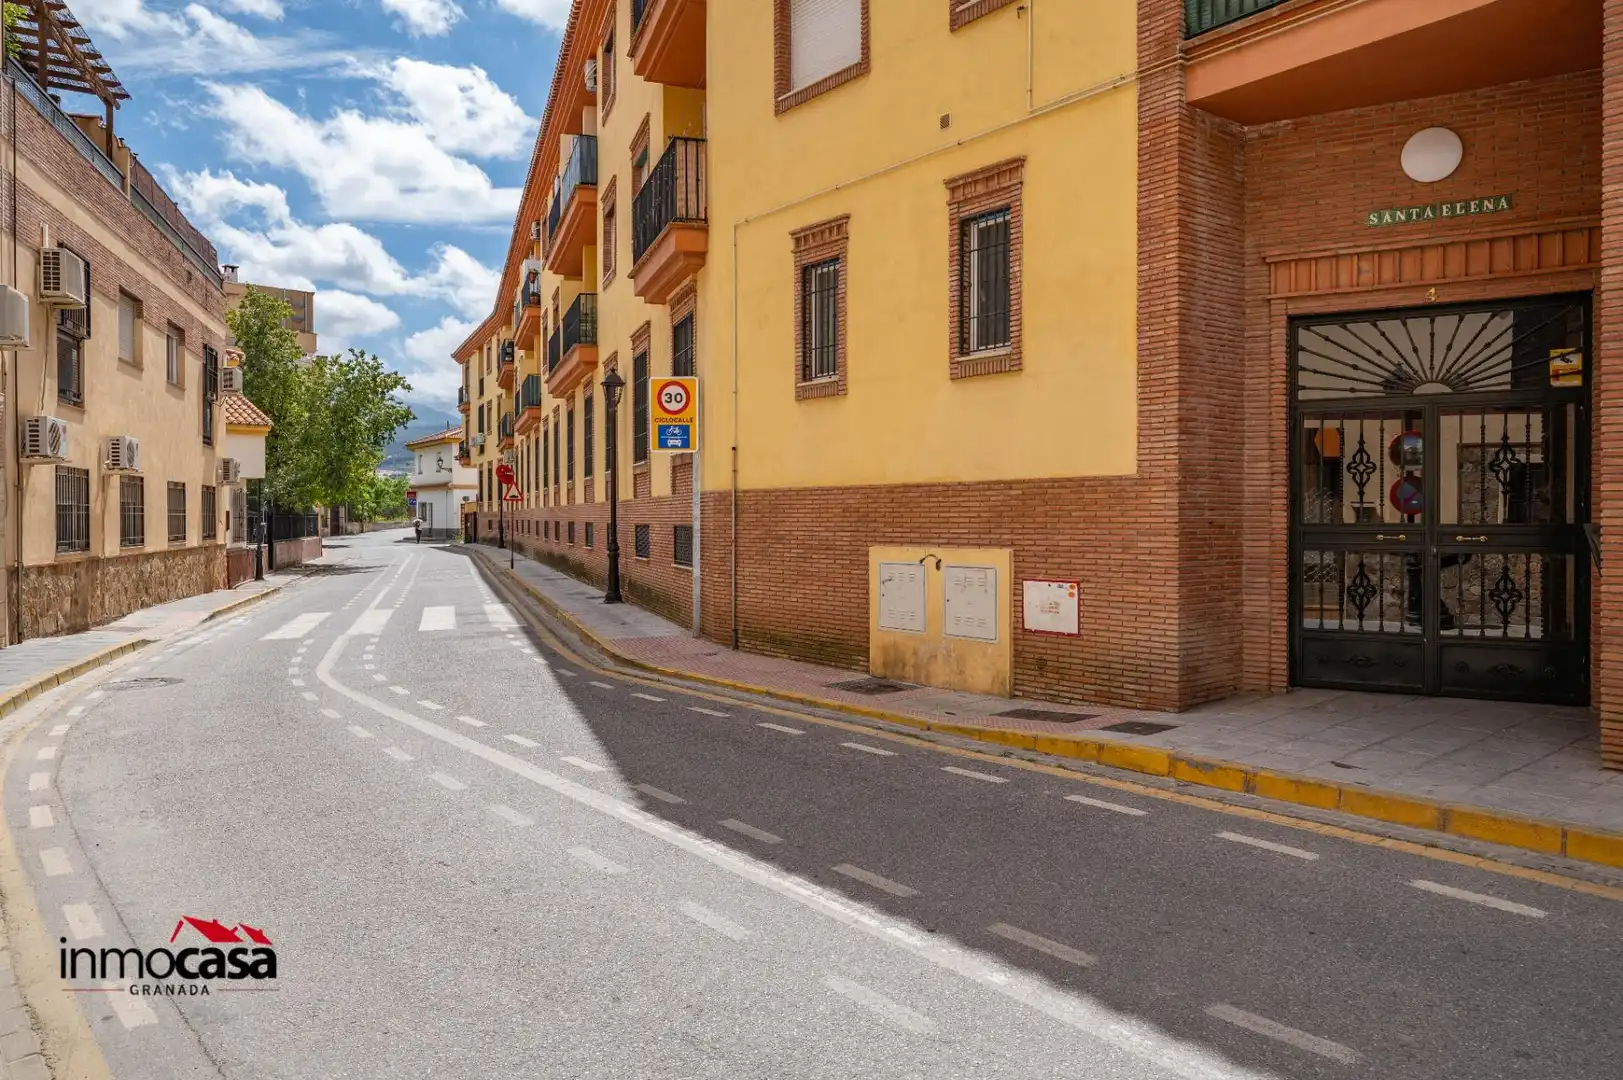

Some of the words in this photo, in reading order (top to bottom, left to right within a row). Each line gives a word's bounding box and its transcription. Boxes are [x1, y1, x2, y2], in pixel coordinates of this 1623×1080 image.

[1369, 205, 1433, 225] SANTA
[1441, 197, 1508, 217] ELENA
[664, 392, 683, 404] 30
